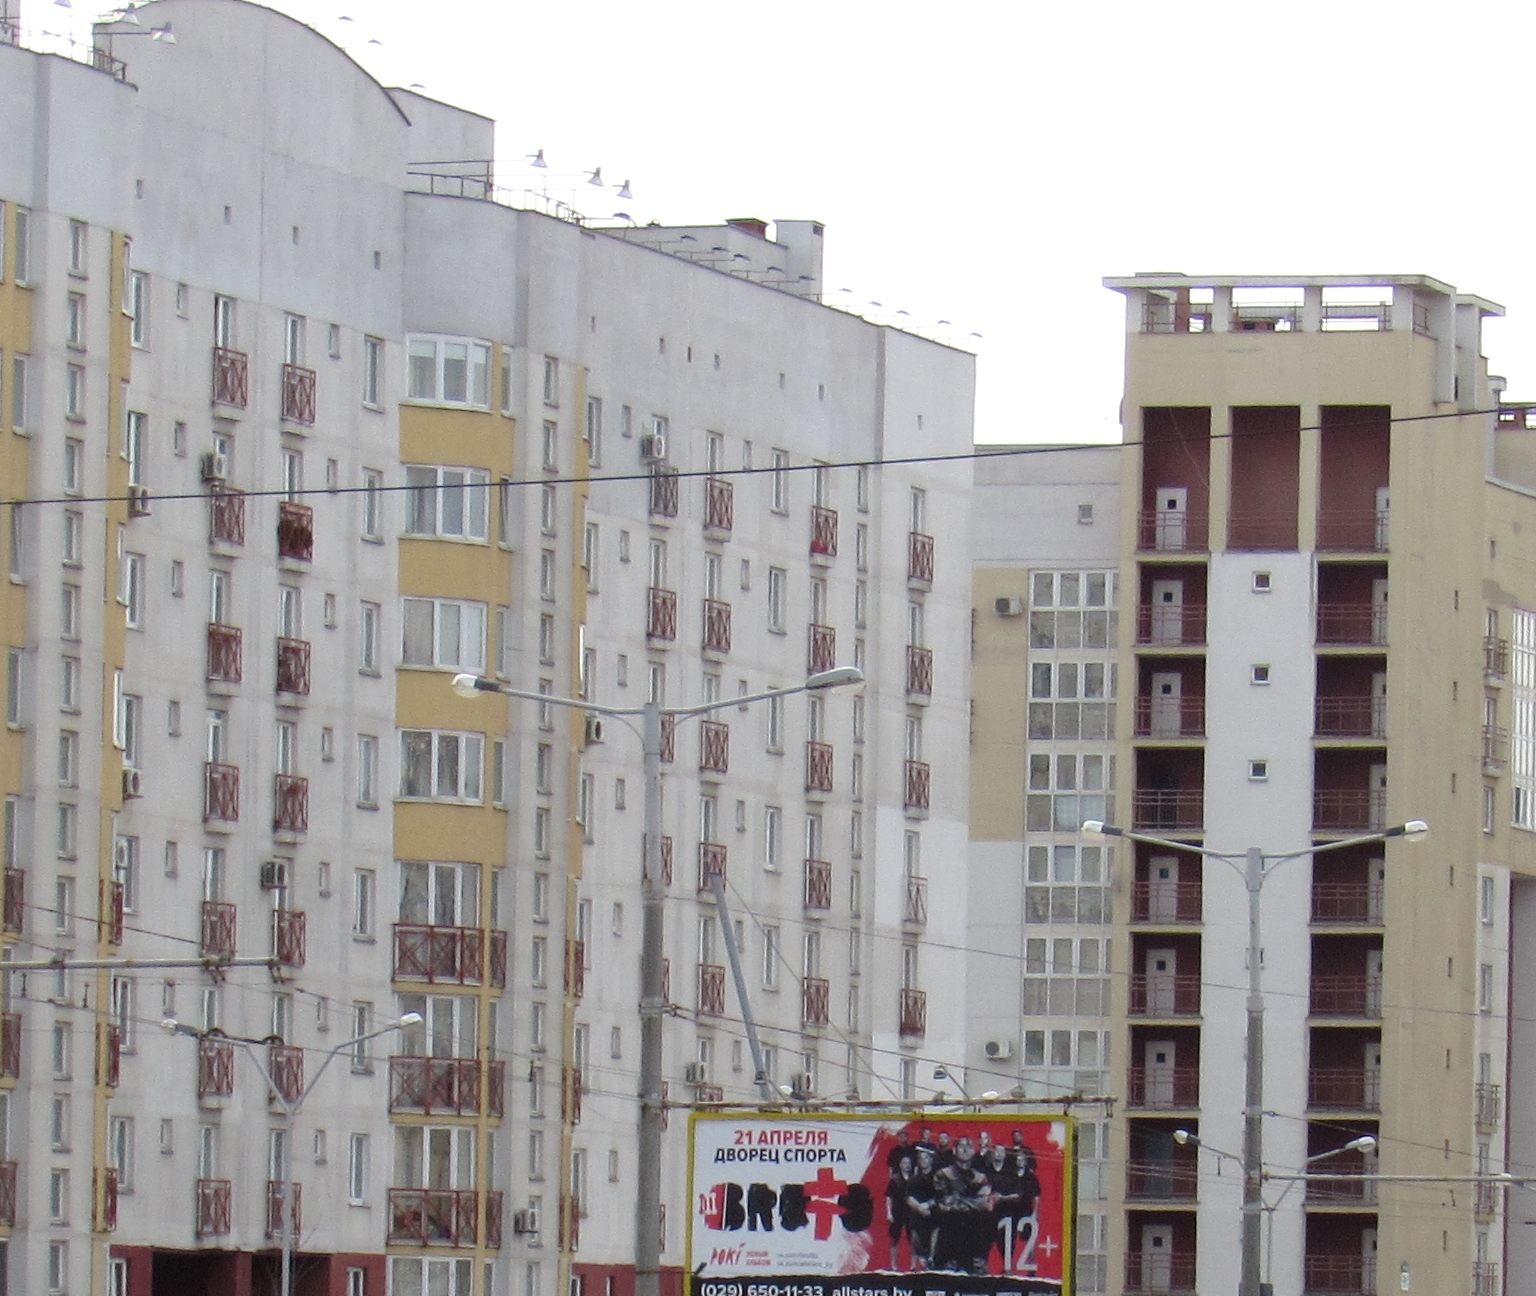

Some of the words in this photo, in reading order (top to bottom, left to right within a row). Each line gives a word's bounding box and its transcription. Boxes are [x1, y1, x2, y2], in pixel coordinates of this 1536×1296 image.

[734, 1130, 752, 1146] 21
[757, 1130, 829, 1146] АПРЕЛЯ
[714, 1148, 780, 1164] ДВОРЕЦ
[783, 1148, 847, 1163] СПОРТА
